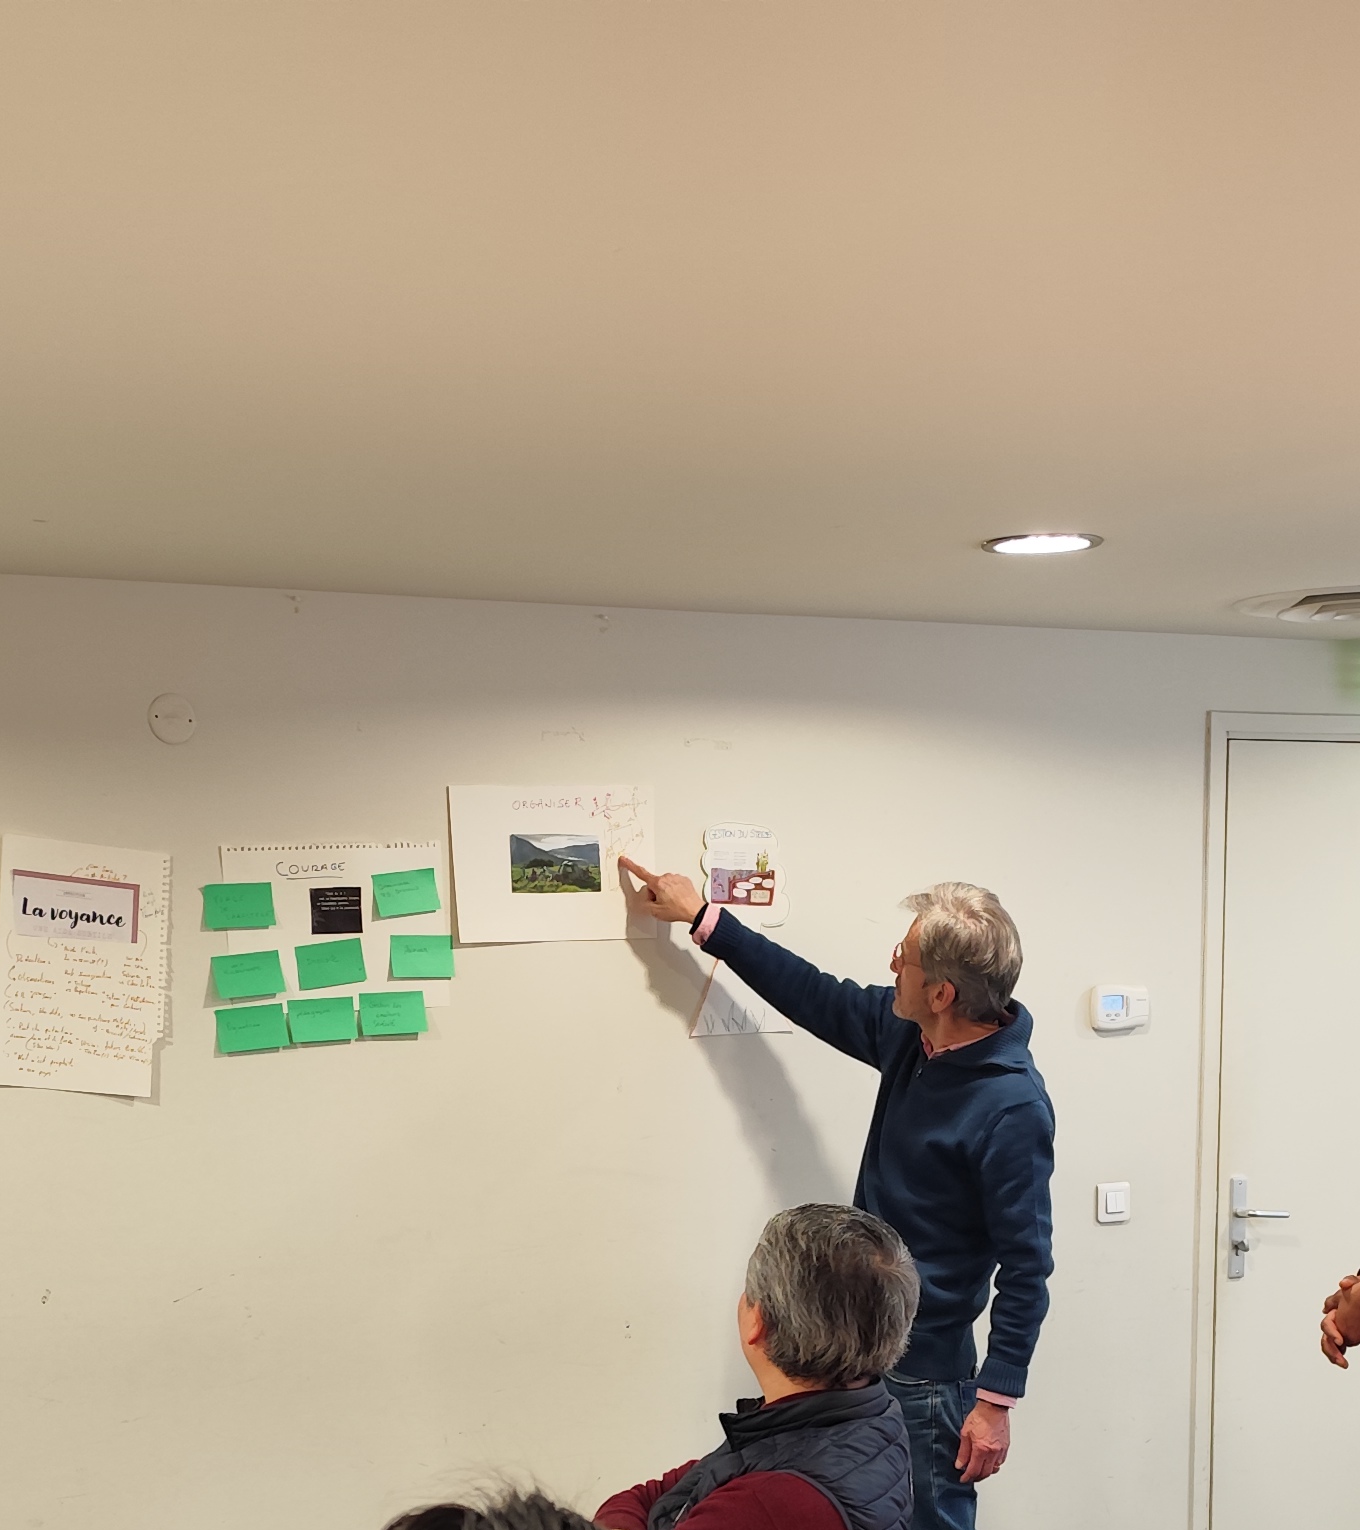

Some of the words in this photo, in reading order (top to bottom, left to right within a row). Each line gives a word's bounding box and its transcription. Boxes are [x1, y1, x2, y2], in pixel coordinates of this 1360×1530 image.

[512, 797, 585, 810] ORGANISER
[275, 861, 346, 876] COURAGE
[21, 896, 47, 918] La
[50, 907, 127, 929] voyance
